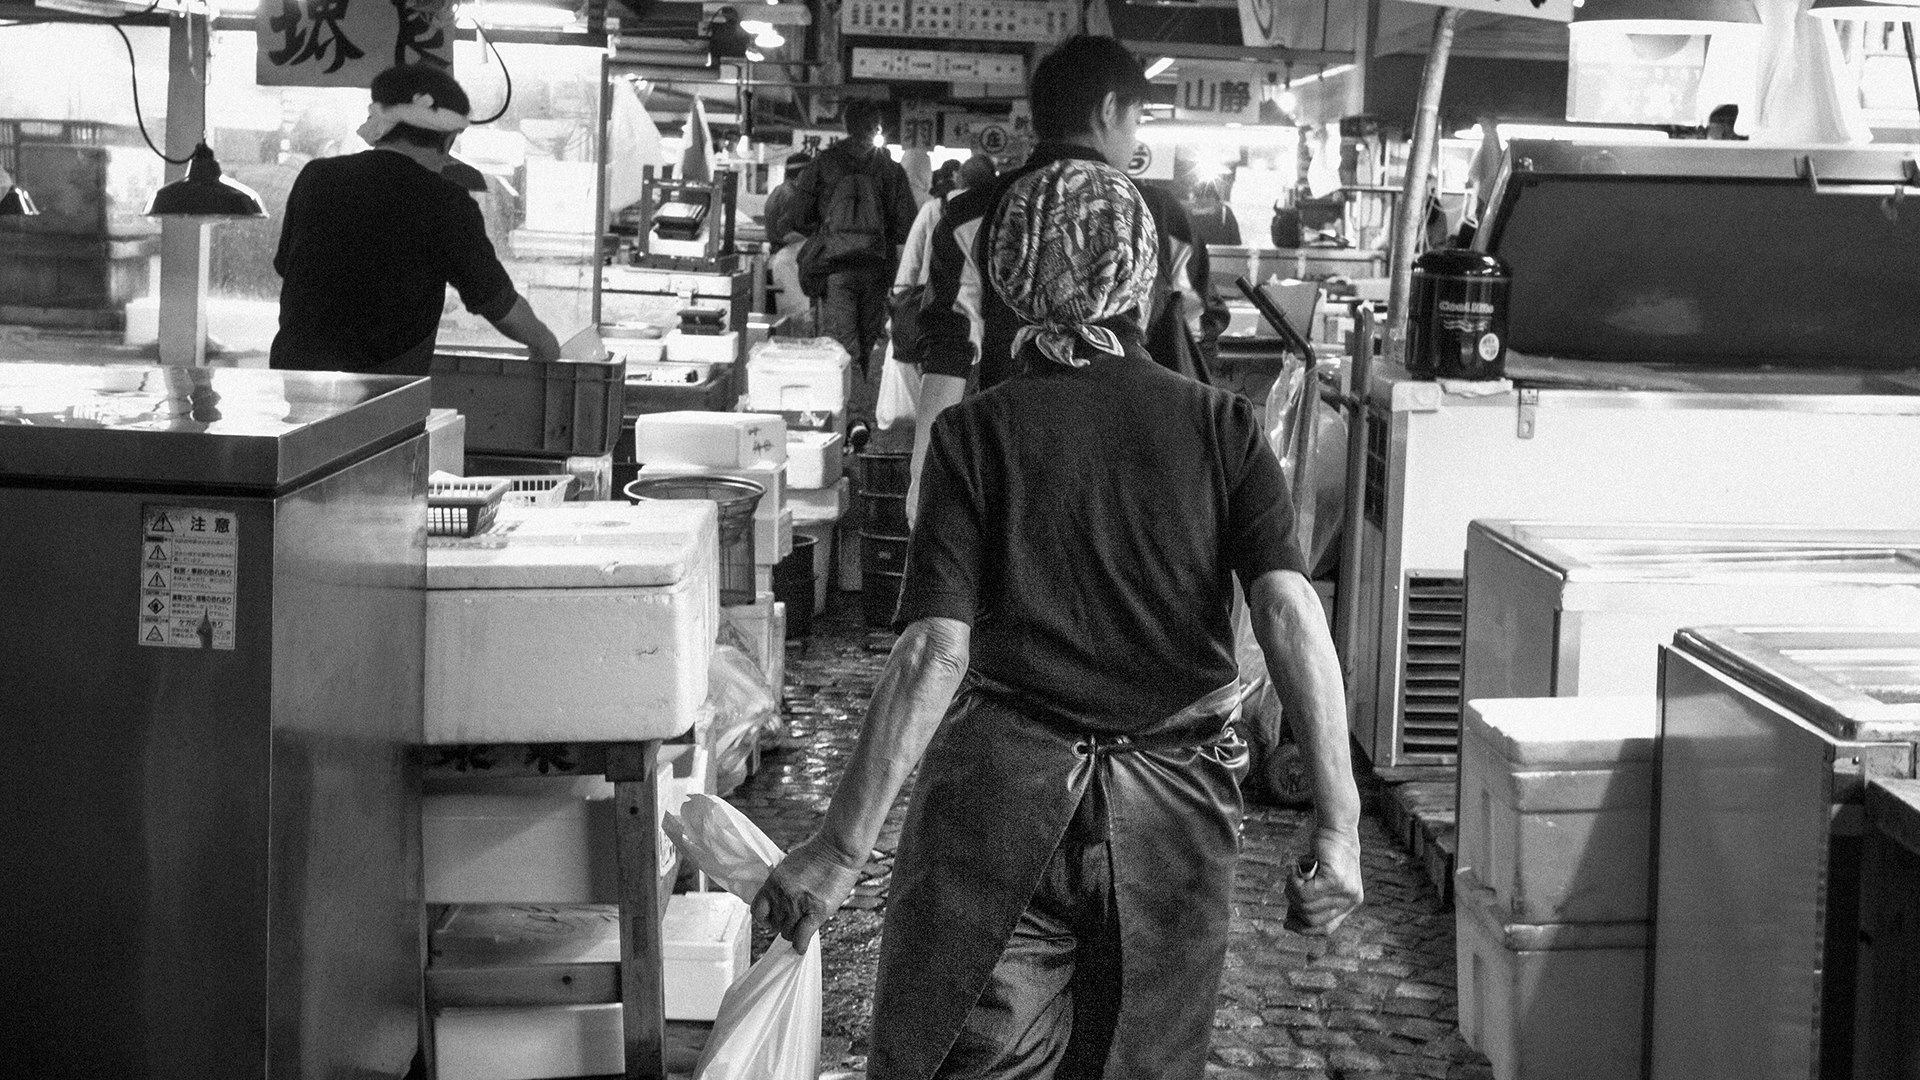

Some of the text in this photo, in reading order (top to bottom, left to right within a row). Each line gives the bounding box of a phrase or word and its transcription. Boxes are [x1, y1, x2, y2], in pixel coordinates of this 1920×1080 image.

[190, 516, 230, 533] 注意
[178, 619, 223, 628] ケガのあり
